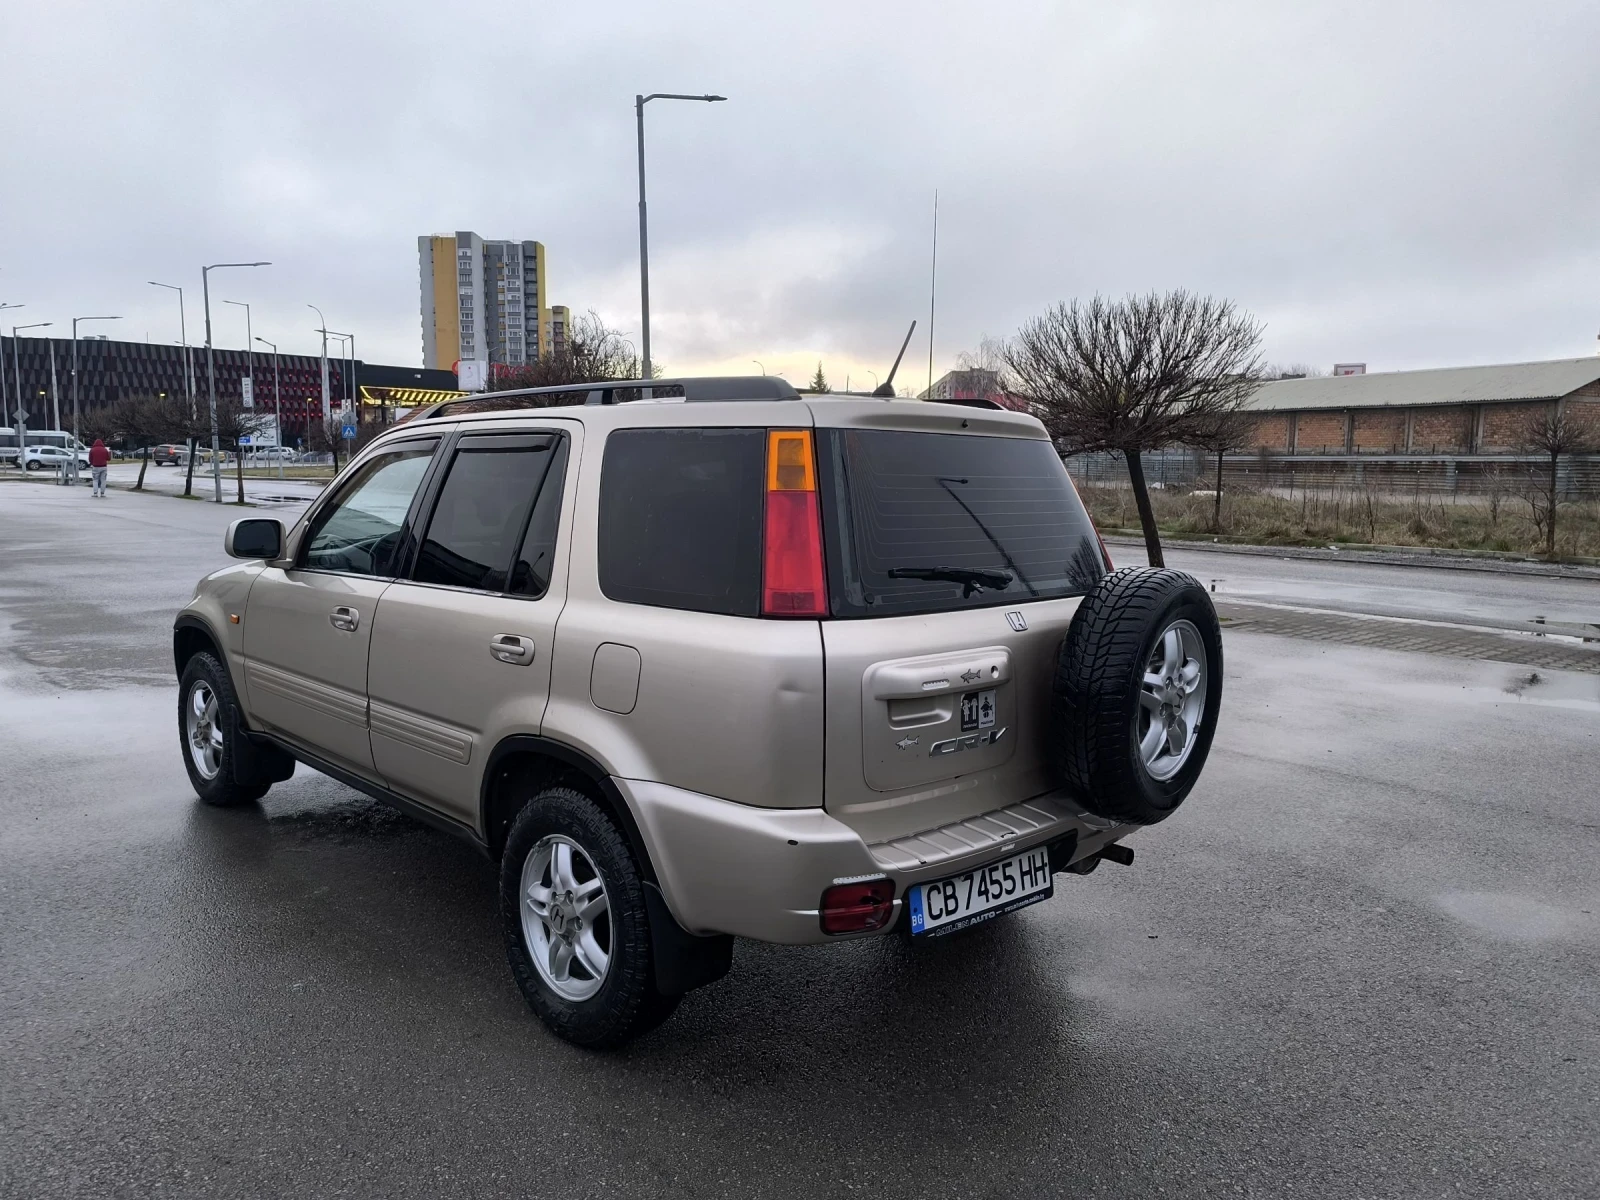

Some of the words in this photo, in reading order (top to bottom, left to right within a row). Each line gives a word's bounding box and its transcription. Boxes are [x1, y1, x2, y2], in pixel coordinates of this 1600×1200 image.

[930, 727, 1007, 757] CR-V
[927, 880, 959, 920] CB
[961, 861, 1016, 910] 7455
[1019, 852, 1047, 891] HH
[911, 914, 923, 927] BG
[970, 911, 996, 925] AUTO
